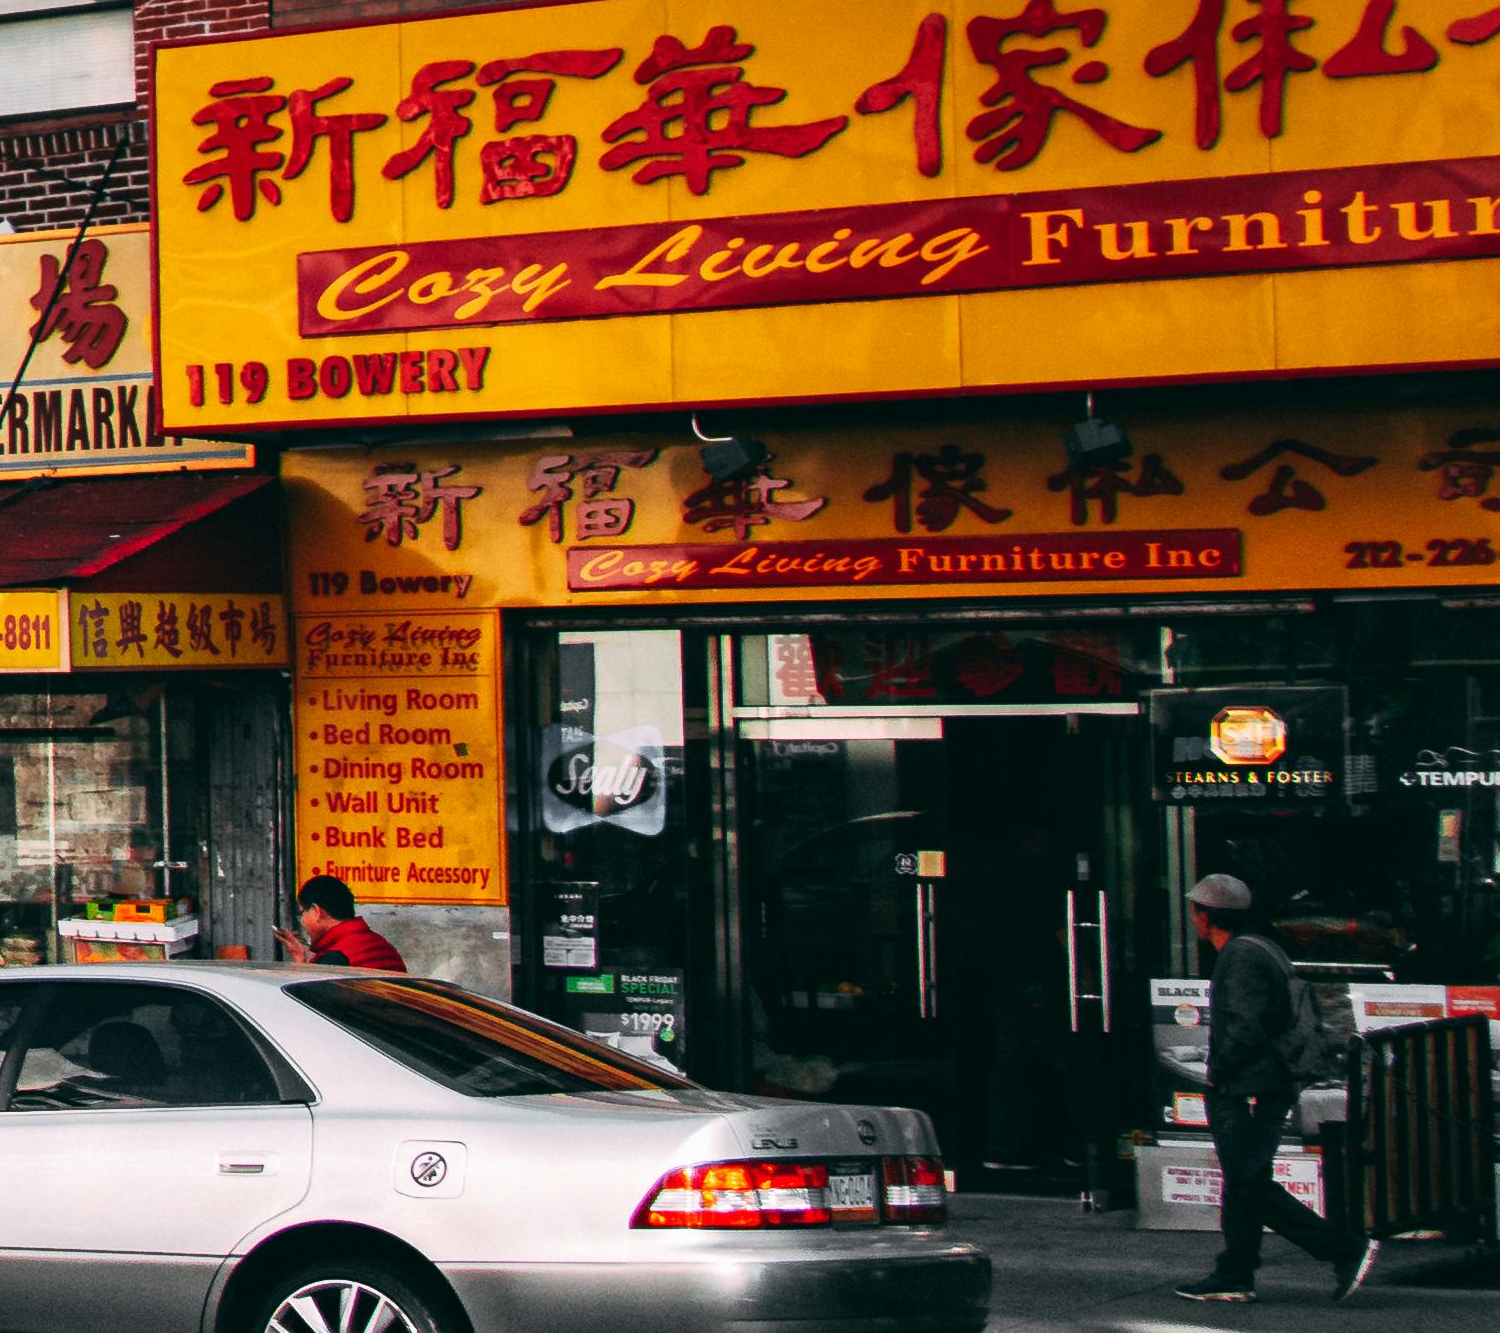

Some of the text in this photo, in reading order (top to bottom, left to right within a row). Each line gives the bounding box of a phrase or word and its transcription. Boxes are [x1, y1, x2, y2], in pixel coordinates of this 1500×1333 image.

[315, 248, 573, 327] Cozy
[594, 223, 999, 291] Living
[184, 346, 491, 407] 119 BOWERY
[578, 540, 1222, 584] Cozy Living Furniture Inc
[308, 569, 473, 600] 119 Bowery
[307, 648, 433, 667] Furniture
[323, 688, 479, 717] Living Room
[323, 722, 451, 745] Bed Room
[323, 757, 485, 784] Dining Room
[555, 753, 649, 806] Sealy
[1166, 771, 1334, 784] STEARNS & FOSTER
[325, 791, 440, 814] Wall Unit
[325, 826, 445, 849] Bunk Bed
[326, 860, 491, 890] Furniture Accessory
[621, 983, 679, 995] SPECIAL
[1157, 986, 1201, 999] BLACK
[620, 1012, 675, 1031] $1999
